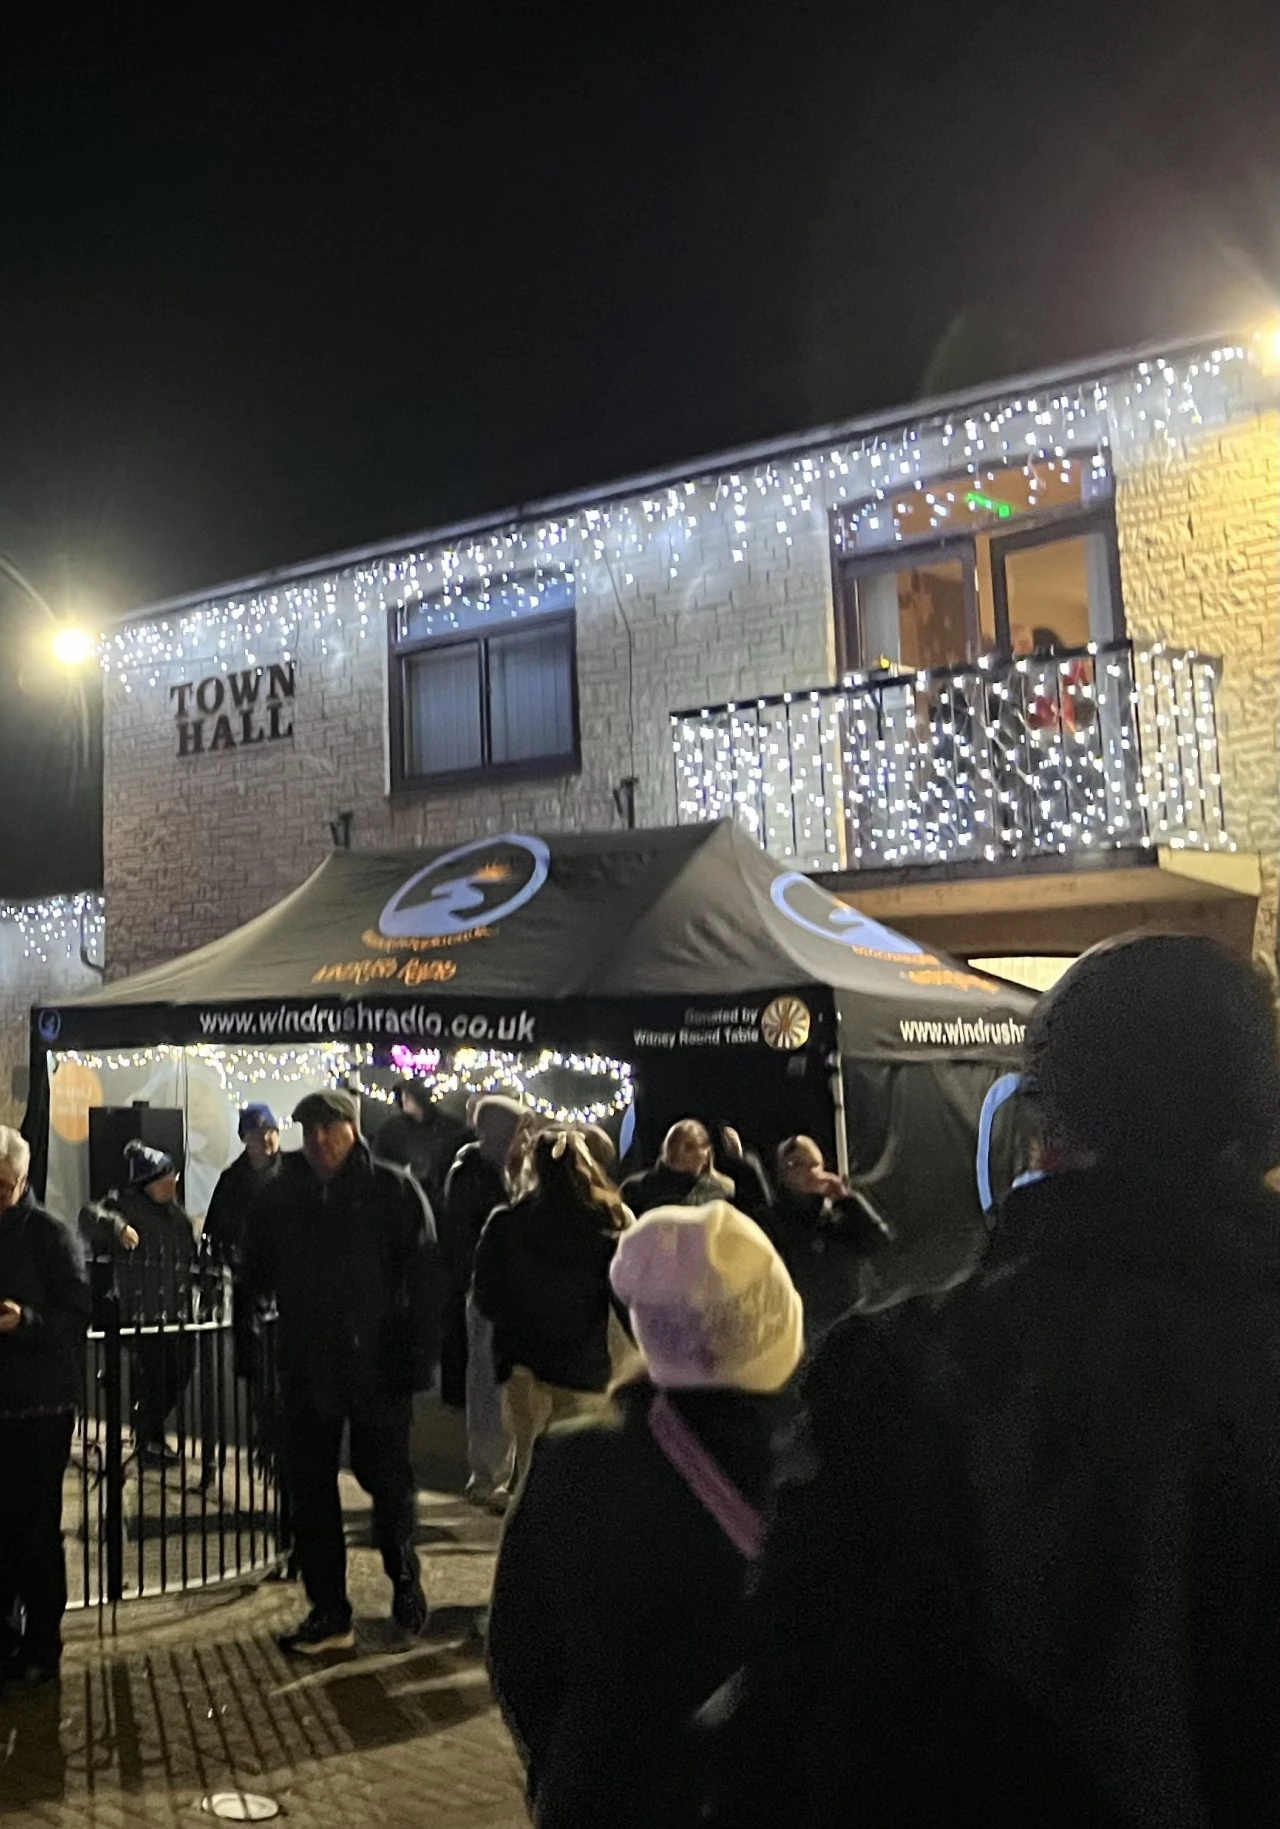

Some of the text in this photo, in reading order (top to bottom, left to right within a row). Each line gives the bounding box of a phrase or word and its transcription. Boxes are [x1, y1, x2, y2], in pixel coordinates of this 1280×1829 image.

[171, 660, 297, 718] TOWN
[176, 702, 293, 757] HALL
[200, 1001, 536, 1042] www.windrushradio.co.uk
[742, 1007, 760, 1025] by
[633, 1029, 676, 1048] Witney
[724, 1027, 759, 1044] Table
